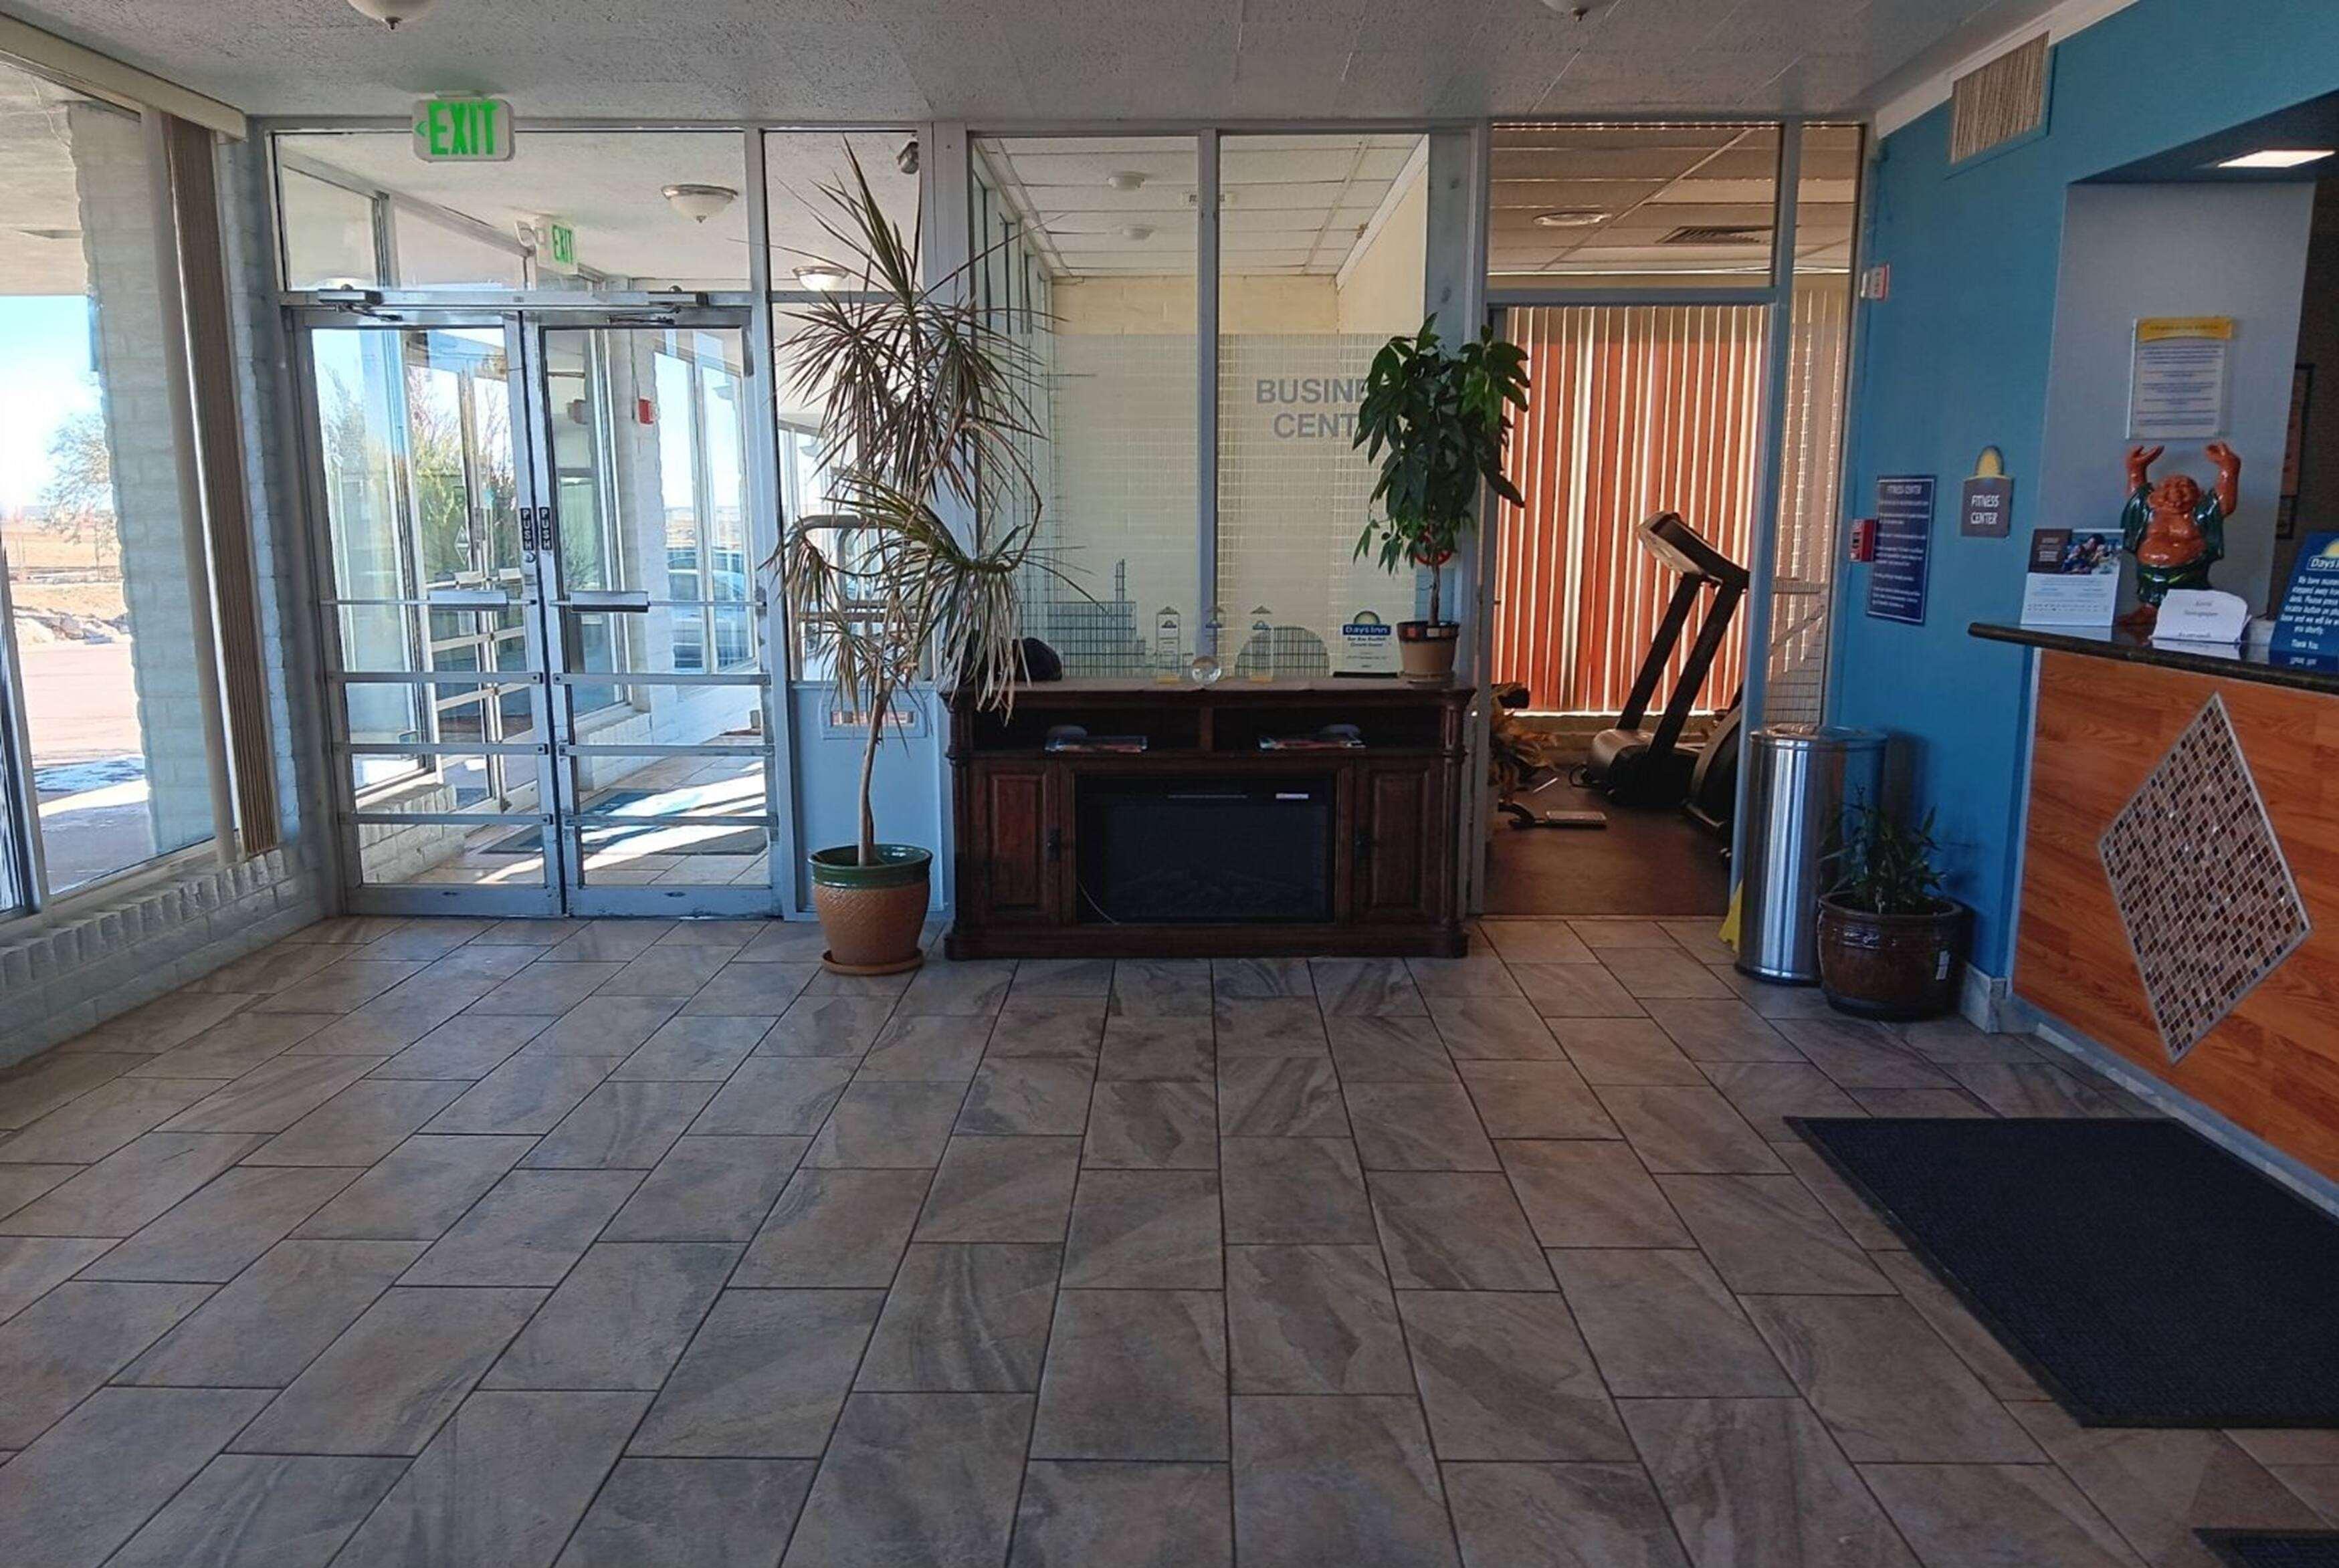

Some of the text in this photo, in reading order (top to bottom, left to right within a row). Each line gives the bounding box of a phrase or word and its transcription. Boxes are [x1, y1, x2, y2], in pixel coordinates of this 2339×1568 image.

[428, 102, 498, 154] EXIT
[552, 225, 573, 264] EXIT
[1257, 378, 1368, 404] BUSINE
[1274, 413, 1358, 438] CENT
[1971, 495, 1999, 508] FITNESS
[522, 510, 532, 550] PUSH
[541, 509, 550, 549] PUSH
[1970, 512, 1998, 524] CENTER
